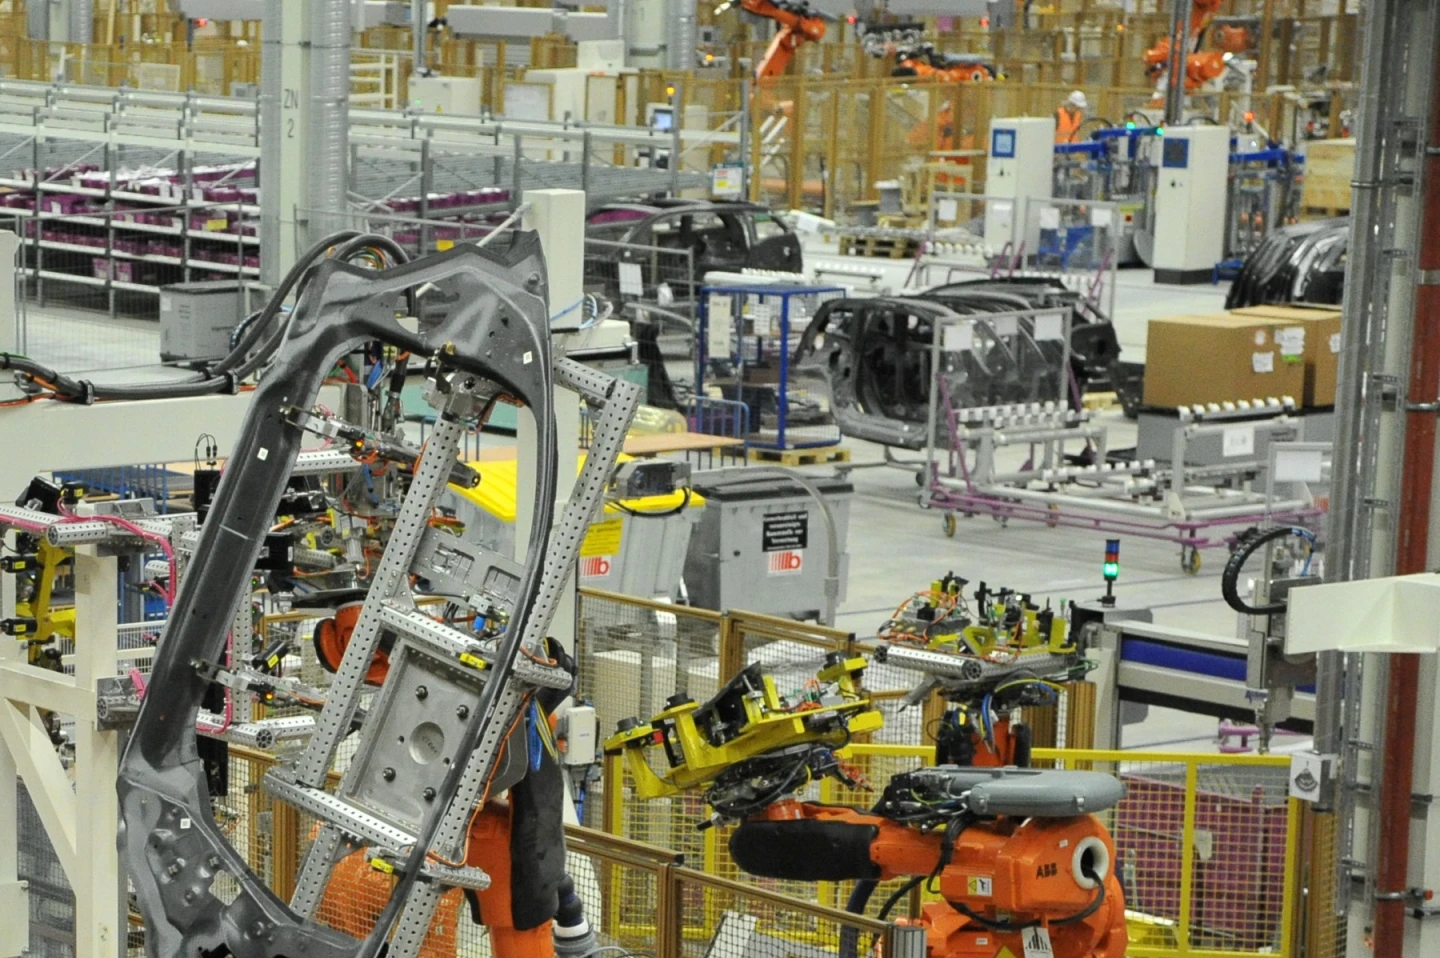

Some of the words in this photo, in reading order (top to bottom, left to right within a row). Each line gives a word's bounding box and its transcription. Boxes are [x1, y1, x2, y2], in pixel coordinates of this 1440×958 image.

[284, 88, 298, 109] ZN
[287, 118, 295, 138] 2
[1035, 862, 1058, 880] ABB
